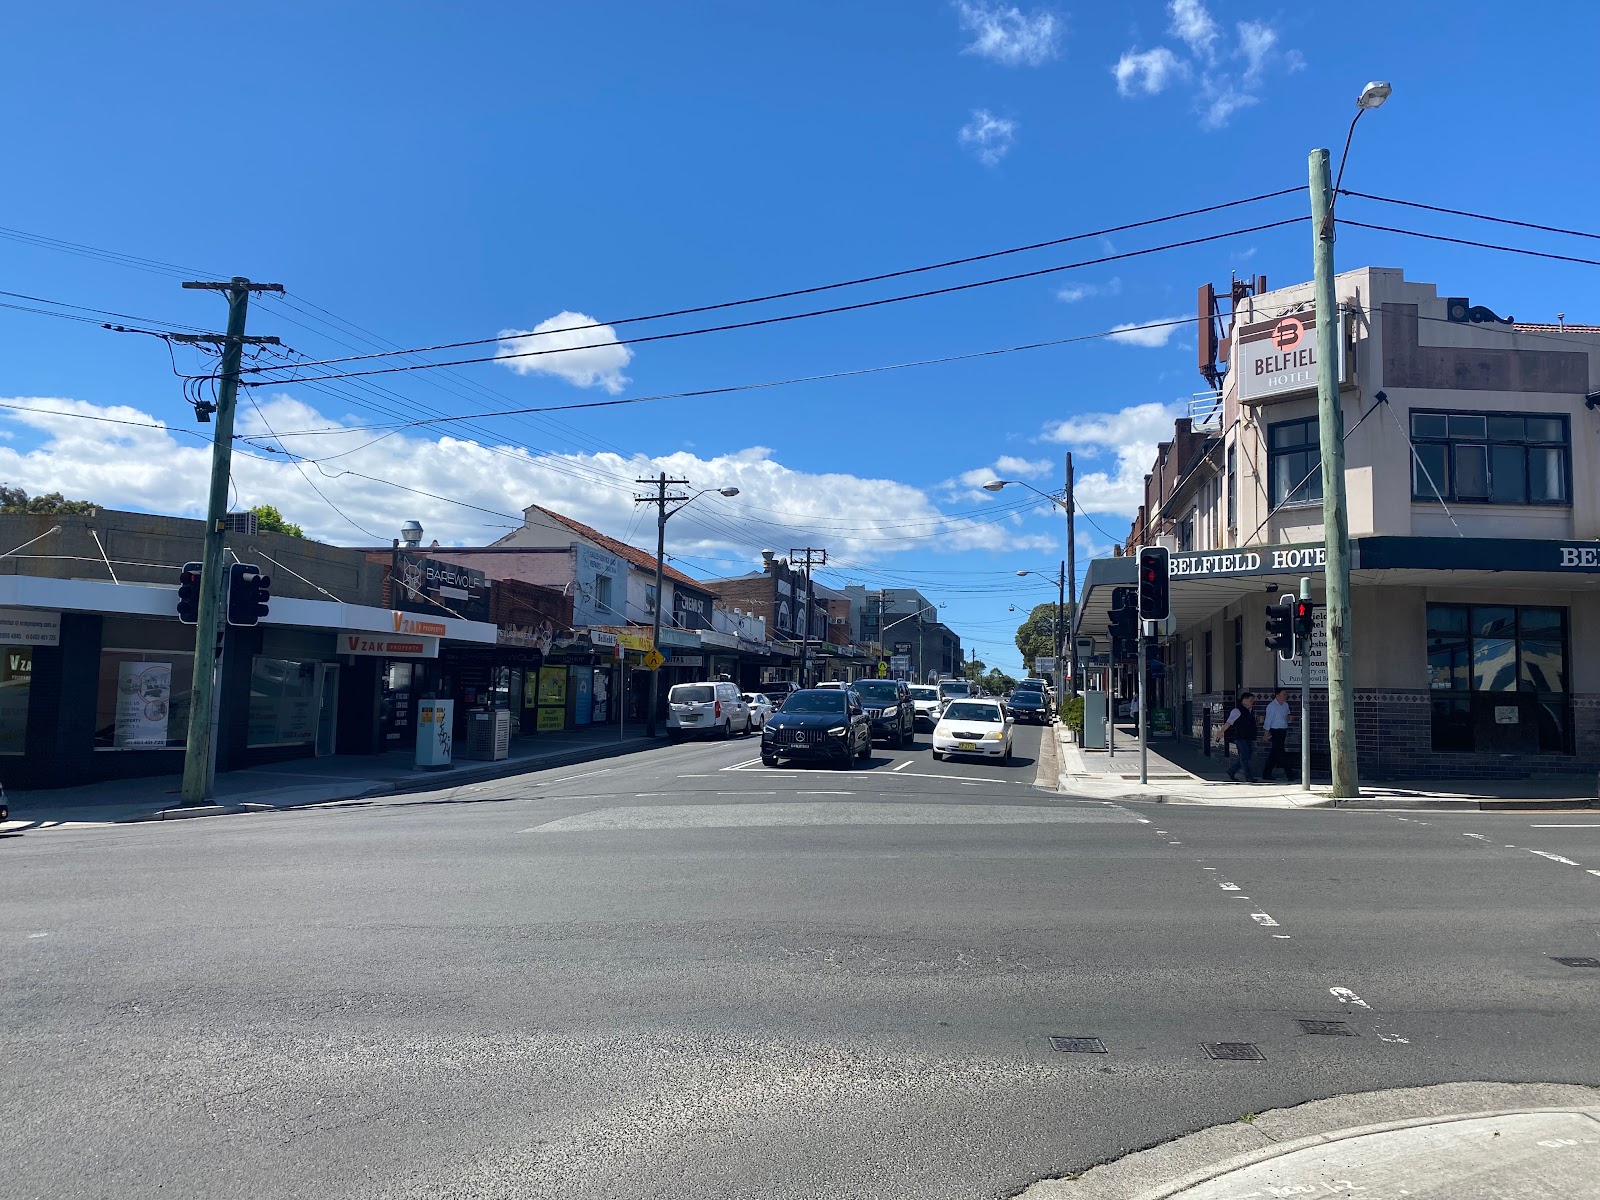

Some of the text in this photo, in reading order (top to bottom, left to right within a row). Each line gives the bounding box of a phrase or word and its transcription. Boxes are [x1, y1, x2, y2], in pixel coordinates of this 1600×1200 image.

[1255, 347, 1317, 376] BELFIEL
[1268, 370, 1312, 387] HOTEL
[1169, 547, 1326, 575] BELFIELD HOTE
[1559, 547, 1600, 567] BE
[426, 567, 480, 589] BAREWOLF
[681, 596, 704, 614] CHEMIST
[422, 625, 443, 633] PROPERTY
[1313, 620, 1324, 628] tel
[9, 654, 32, 671] VZA
